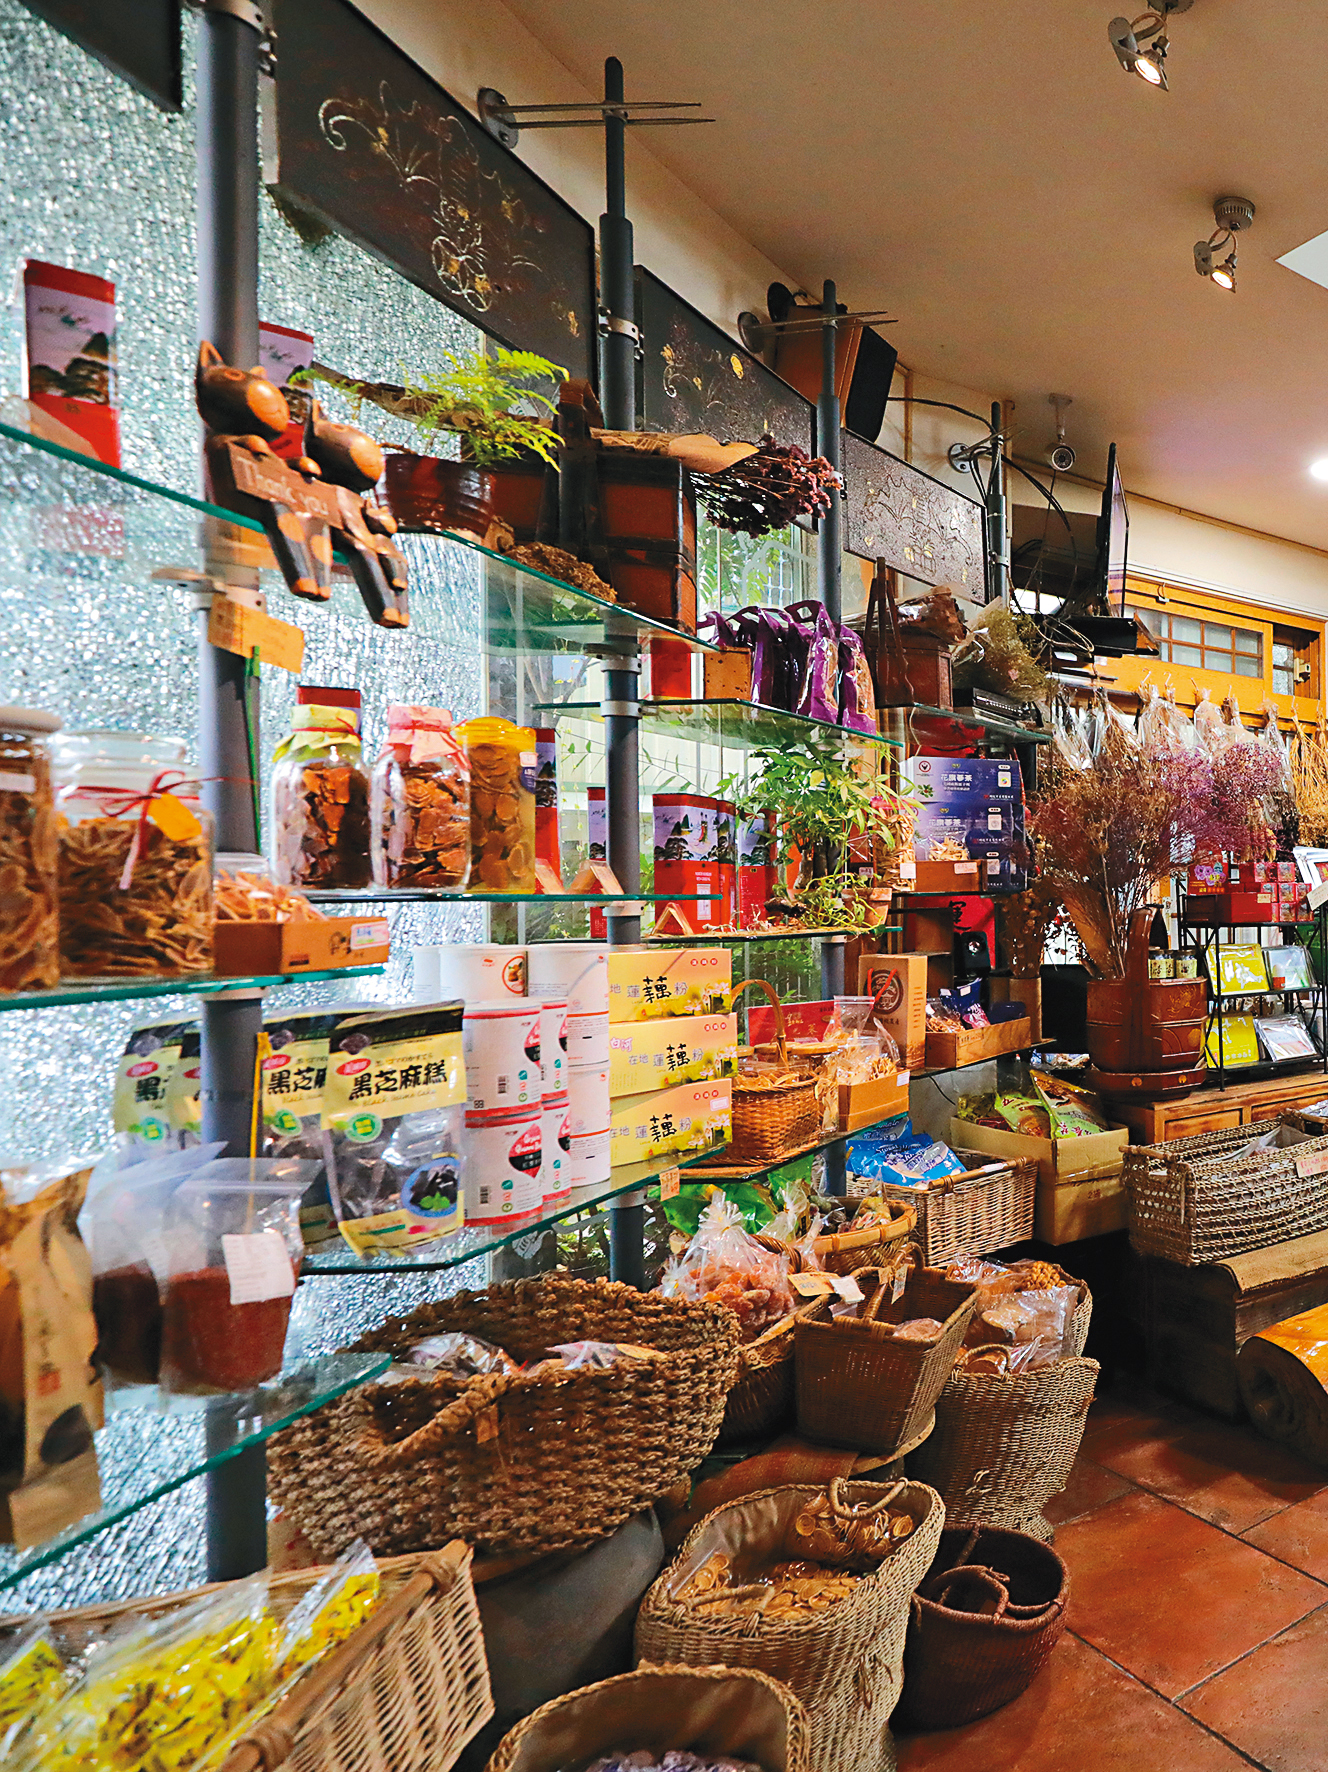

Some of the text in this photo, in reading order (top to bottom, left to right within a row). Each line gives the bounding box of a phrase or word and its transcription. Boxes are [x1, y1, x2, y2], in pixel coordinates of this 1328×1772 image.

[236, 456, 329, 516] Thank you
[349, 1059, 447, 1101] 黑芝麻糕
